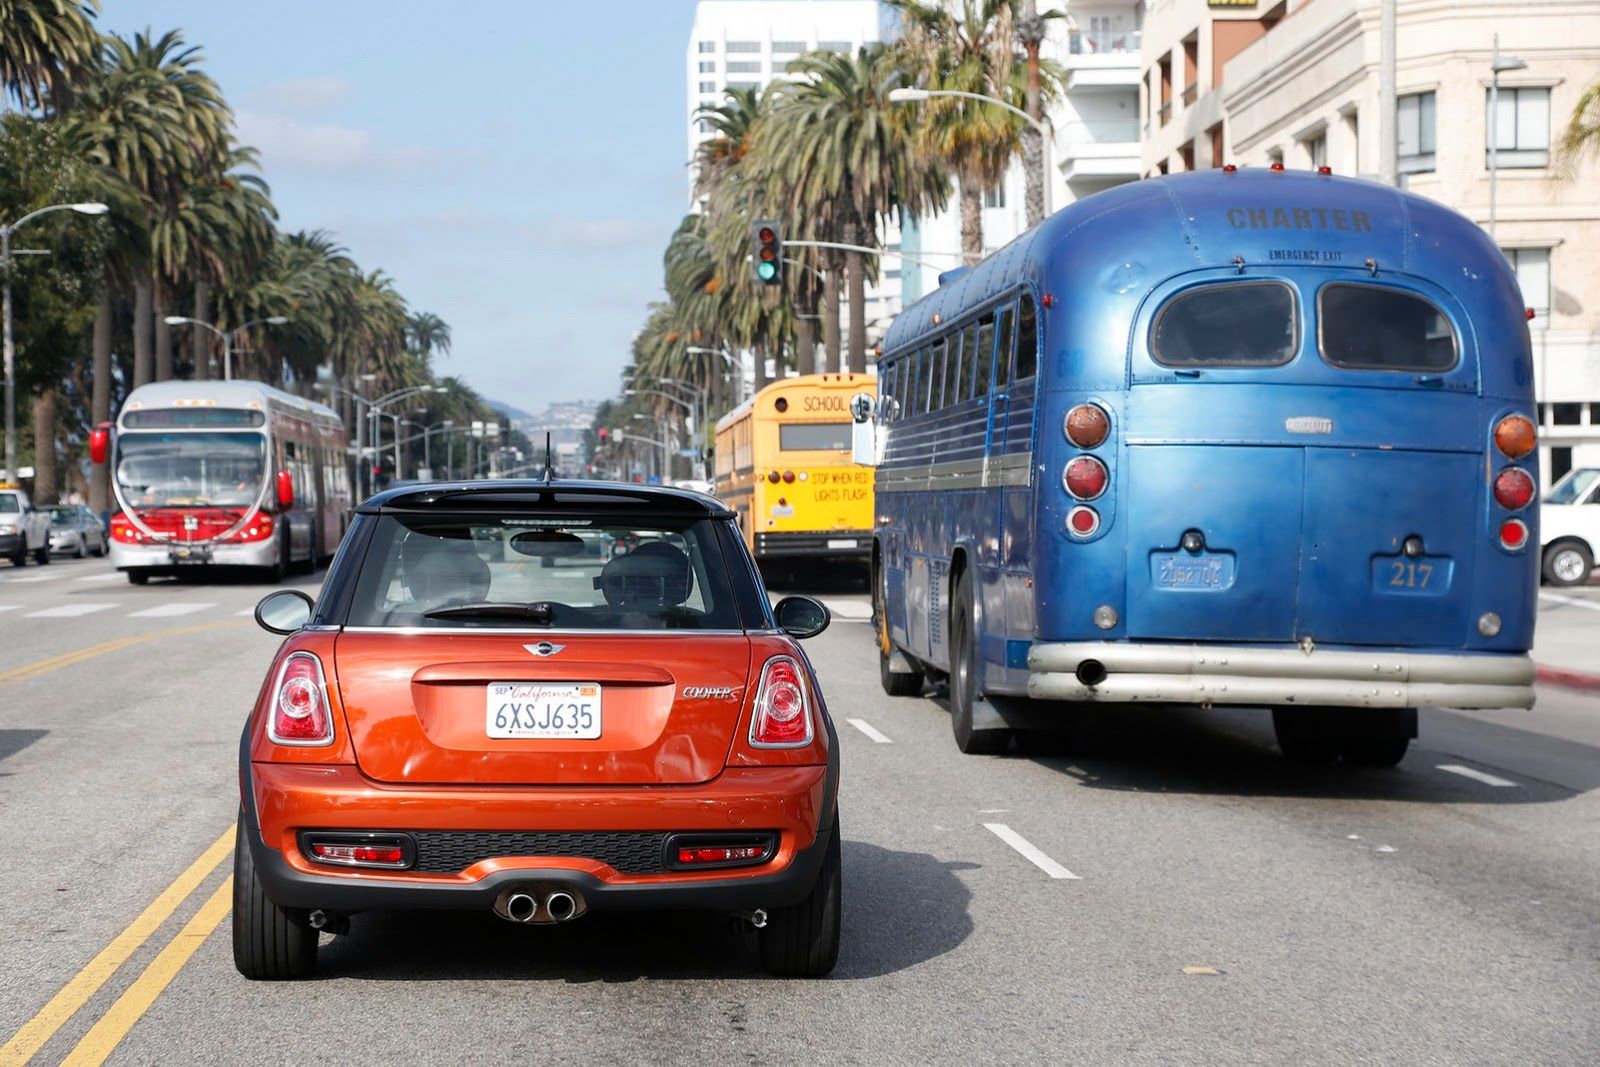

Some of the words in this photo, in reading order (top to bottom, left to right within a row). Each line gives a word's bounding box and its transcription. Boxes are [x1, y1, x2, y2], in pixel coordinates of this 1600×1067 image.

[1226, 206, 1373, 233] CHARTER
[1268, 249, 1319, 261] EMERGENCY
[1323, 250, 1342, 262] EXIT
[804, 396, 847, 412] SCHOOL
[812, 472, 829, 485] STOP
[831, 472, 852, 485] WHEN
[855, 471, 869, 485] RED
[814, 488, 840, 502] LIGHTS
[842, 488, 868, 501] FLASH
[1390, 561, 1433, 588] 217
[494, 686, 508, 696] SEP
[511, 685, 579, 702] California
[682, 686, 731, 699] COOPER
[495, 703, 593, 729] 6XSJ635
